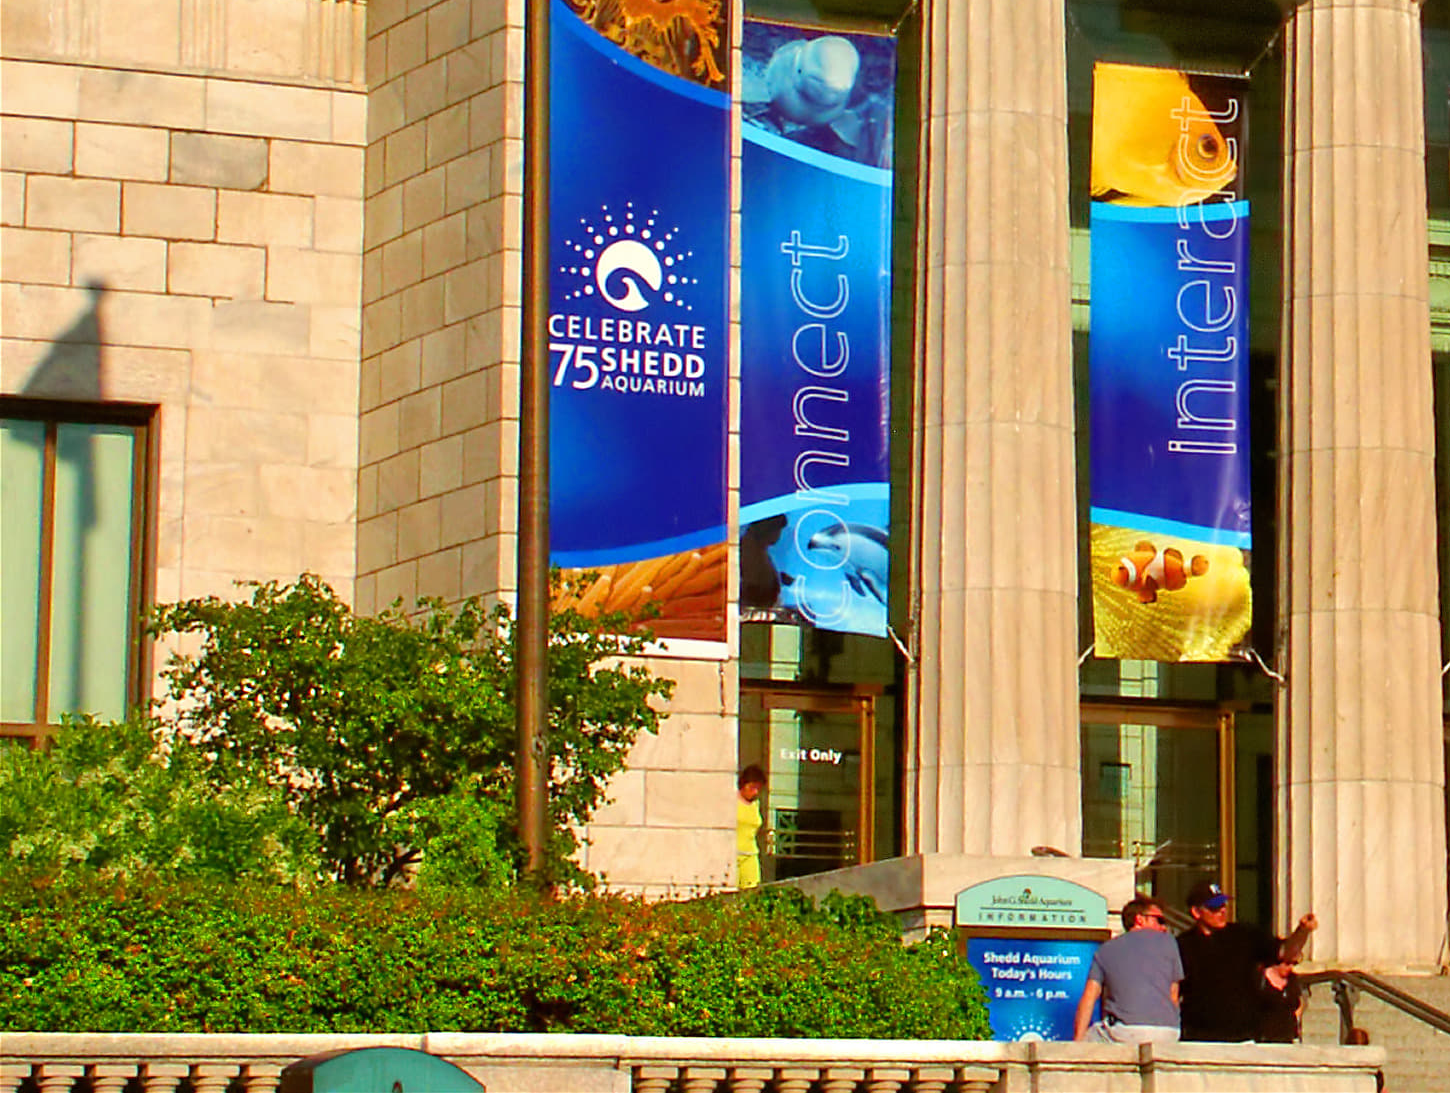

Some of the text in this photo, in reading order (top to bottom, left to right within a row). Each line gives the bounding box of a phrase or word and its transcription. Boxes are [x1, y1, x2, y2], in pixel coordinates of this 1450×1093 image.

[1168, 96, 1238, 455] interact
[548, 313, 706, 349] CELEBRATE
[548, 342, 706, 390] 75 SHEDD
[600, 375, 706, 397] AQUARIUM
[781, 230, 850, 624] connect
[781, 748, 841, 764] Exit Only
[978, 912, 1087, 923] INFORMATION
[983, 951, 1081, 966] Shedd Aquarium
[991, 967, 1073, 981] Today's Hours
[995, 987, 1003, 999] 9
[1036, 988, 1044, 1000] 6
[1045, 990, 1070, 1001] p.m.
